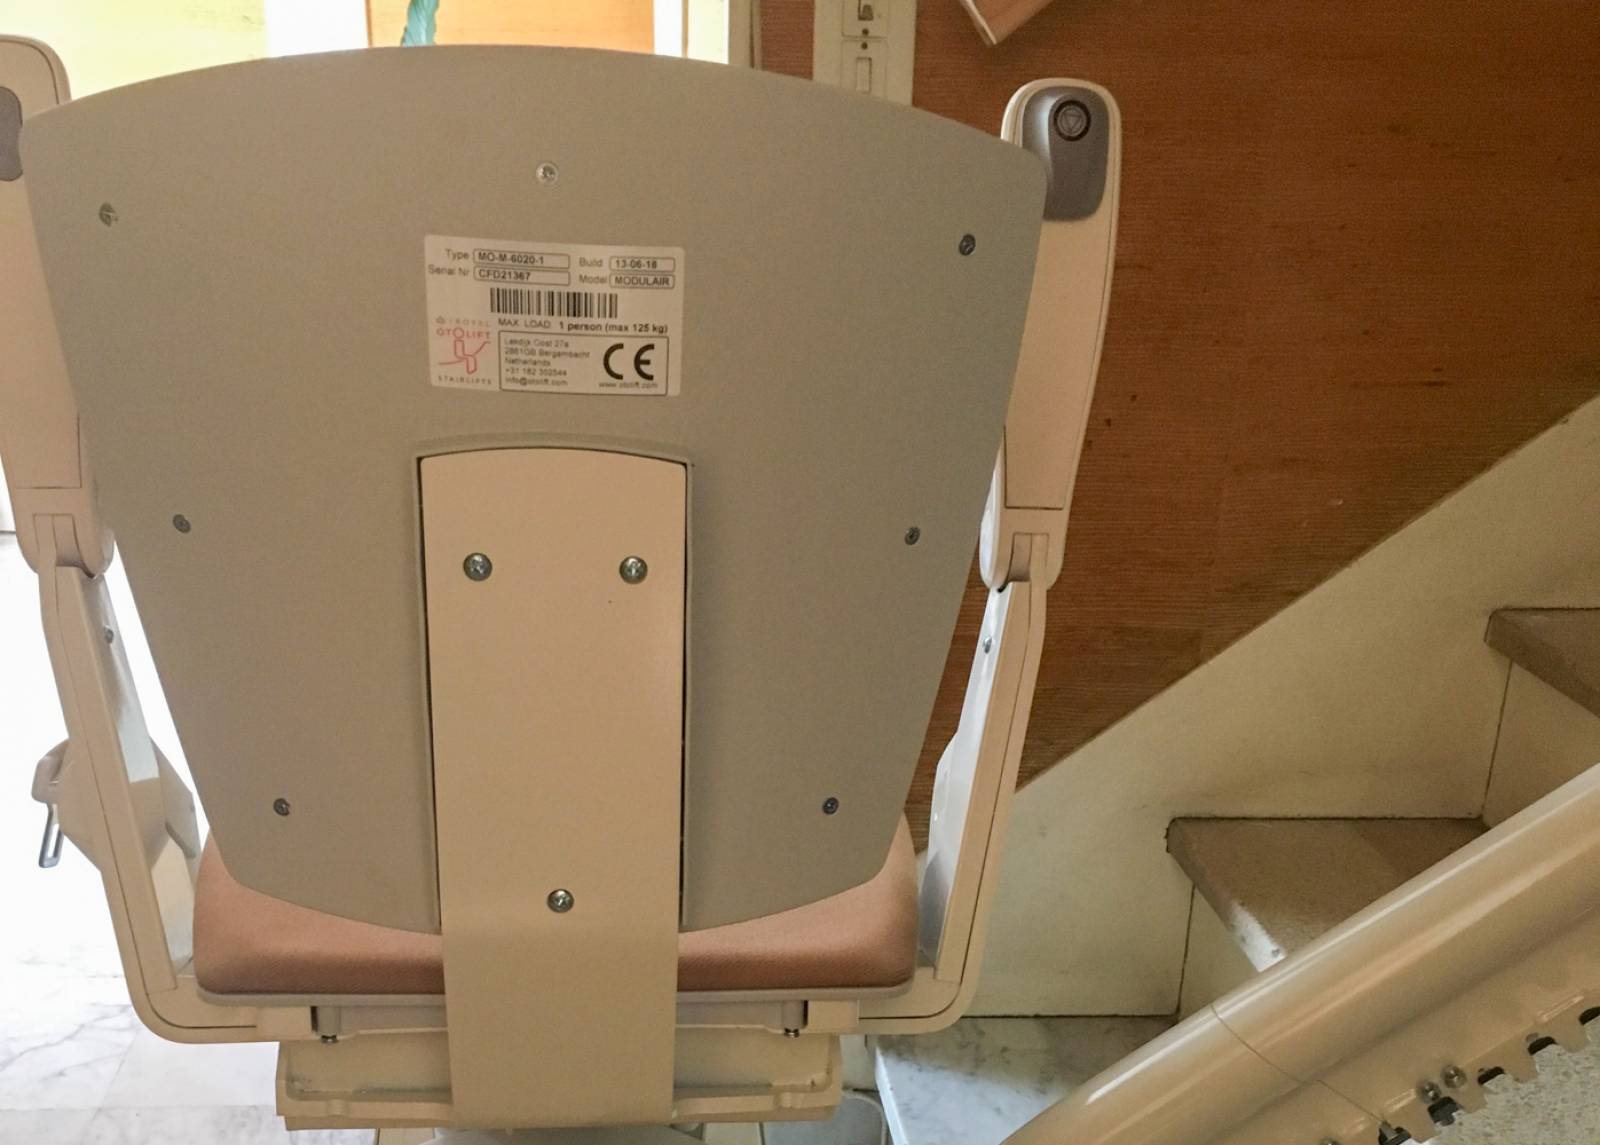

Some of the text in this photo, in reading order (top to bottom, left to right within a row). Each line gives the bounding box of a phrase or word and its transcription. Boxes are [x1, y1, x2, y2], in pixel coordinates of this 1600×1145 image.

[445, 248, 470, 262] Type
[579, 274, 671, 287] Model MODULAIR
[498, 318, 520, 328] MAX
[567, 323, 602, 332] person
[605, 323, 629, 333] (max
[633, 323, 650, 332] 125
[652, 324, 669, 334] kg)
